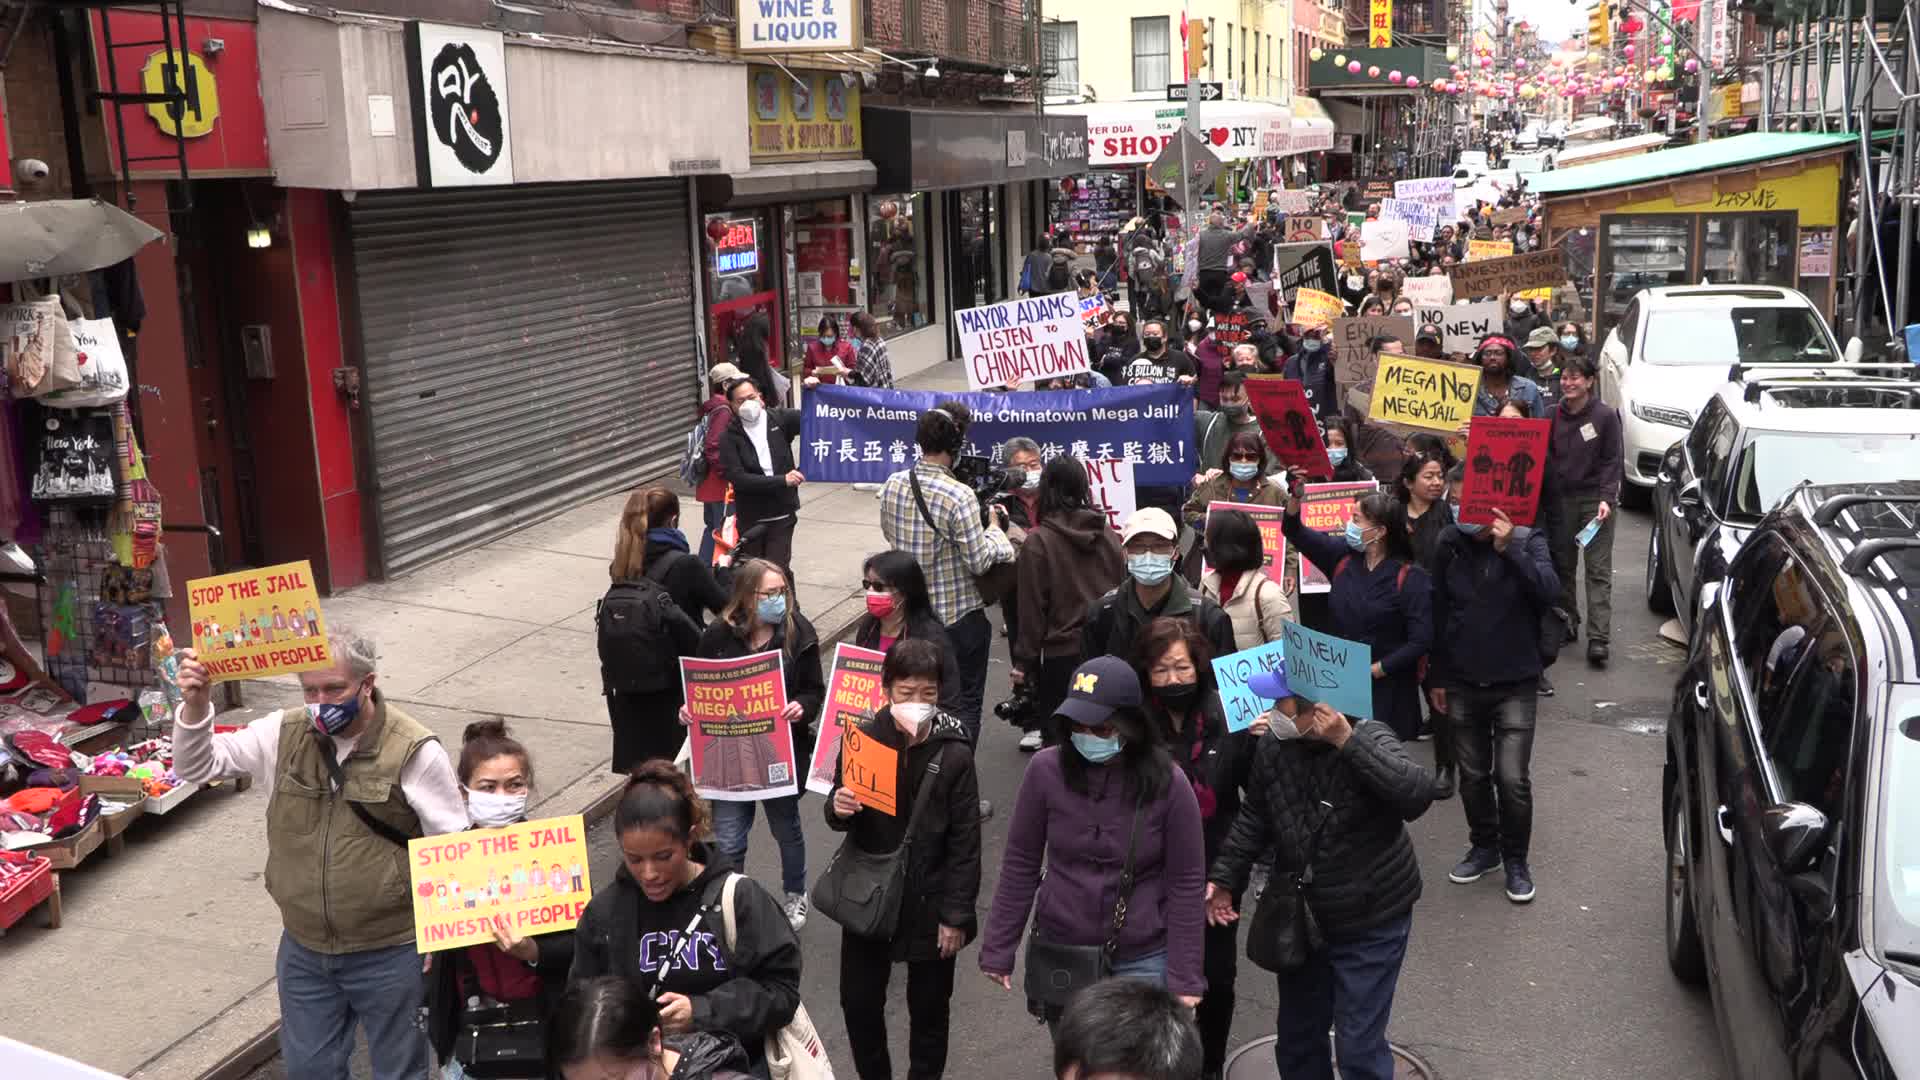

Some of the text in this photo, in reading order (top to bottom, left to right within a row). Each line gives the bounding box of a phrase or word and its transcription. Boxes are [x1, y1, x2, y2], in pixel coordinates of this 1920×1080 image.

[758, 0, 833, 18] WINE &
[753, 21, 838, 42] LIQUOR
[1112, 125, 1134, 134] DUA
[1232, 126, 1257, 147] NY
[1398, 182, 1420, 195] ERIC
[1292, 218, 1313, 230] NO
[1282, 256, 1321, 287] STOP THE
[1452, 263, 1506, 280] INVEST
[1464, 278, 1495, 295] NOT
[961, 306, 1011, 334] MAYOR
[1017, 294, 1075, 326] ADAMS
[1420, 309, 1489, 337] NO NEW
[979, 325, 1058, 351] LISTEN TO
[973, 338, 1086, 386] CHINATOWN
[1135, 364, 1164, 377] BILLION
[1385, 366, 1473, 404] MEGA NO
[816, 403, 862, 421] Mayor
[866, 406, 918, 421] Adams
[998, 407, 1087, 423] Chinatown
[1092, 407, 1138, 422] Mega
[1143, 404, 1179, 419] Jail!
[1307, 503, 1341, 515] STOP
[1305, 515, 1344, 528] MEGA
[192, 572, 307, 607] STOP THE JAIL
[252, 653, 268, 670] IN
[271, 644, 327, 667] PEOPLE
[1283, 624, 1348, 669] NO NEW
[1073, 672, 1098, 694] M
[1219, 659, 1252, 688] NO
[1290, 656, 1339, 689] JAILS
[694, 680, 774, 700] STOP THE
[842, 674, 875, 694] STOP
[692, 697, 780, 718] MEGA JAIL
[834, 690, 872, 711] MEGA
[843, 718, 862, 753] NO
[417, 826, 577, 867] STOP THE JAIL
[423, 916, 489, 944] INVEST
[517, 900, 586, 928] PEOPLE
